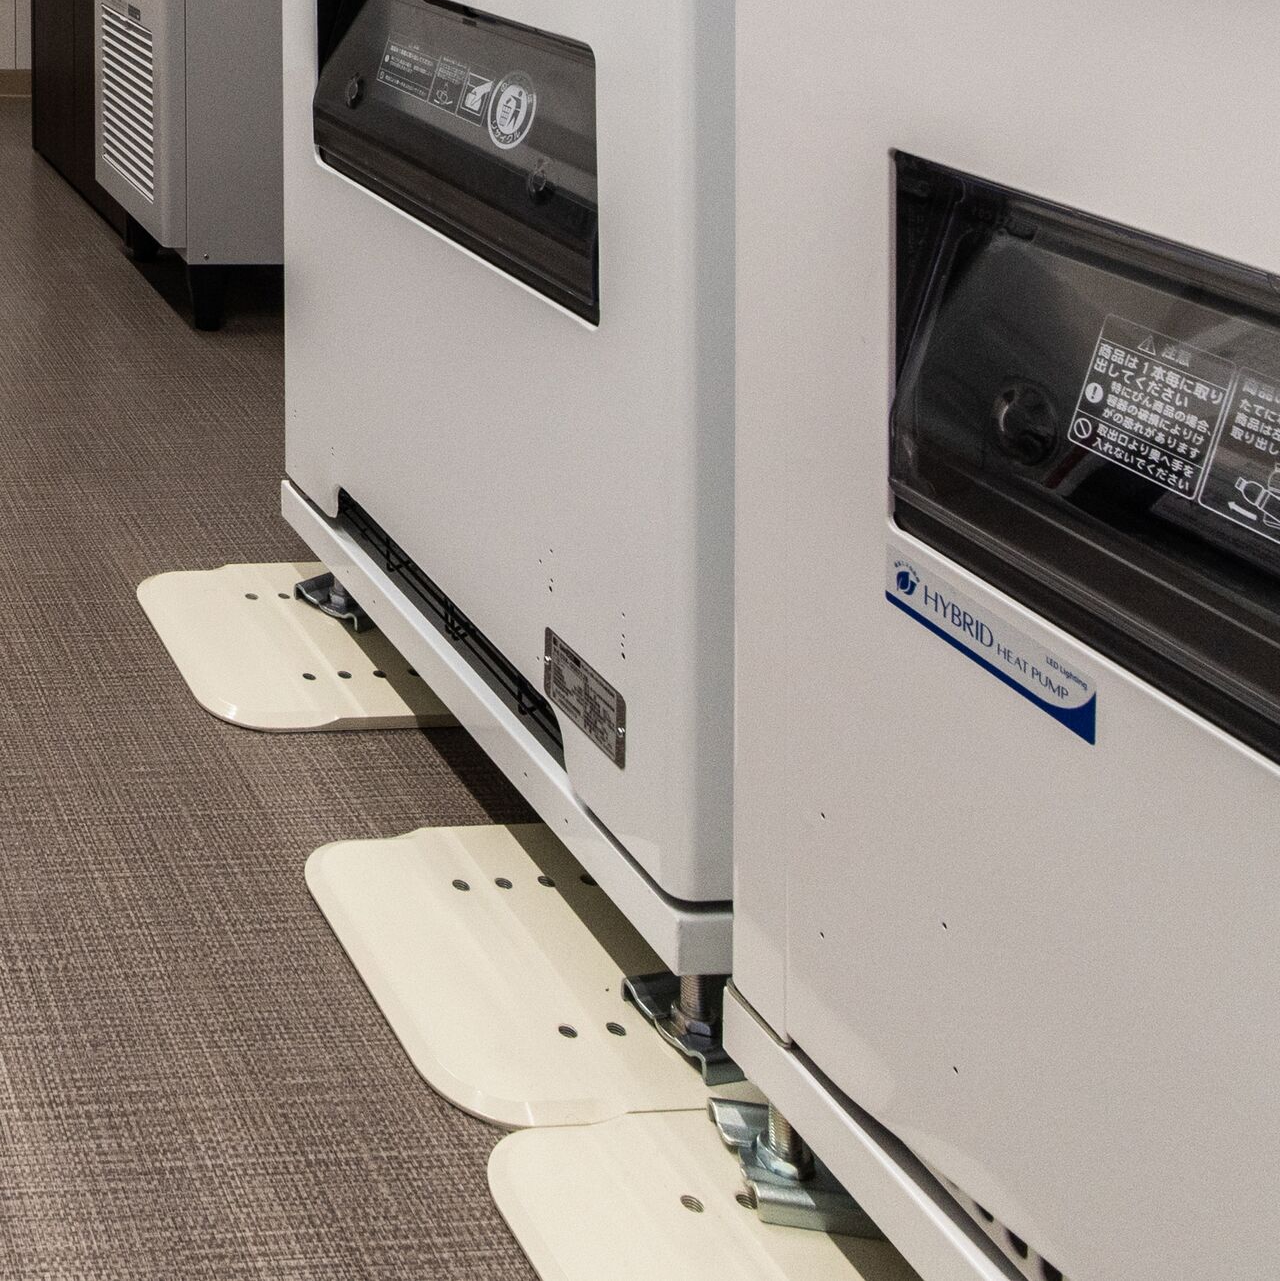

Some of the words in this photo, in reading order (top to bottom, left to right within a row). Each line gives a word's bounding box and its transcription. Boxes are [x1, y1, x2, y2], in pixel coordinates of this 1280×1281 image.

[1092, 357, 1190, 408] 出してください
[1090, 435, 1191, 492] 入れないでください
[924, 585, 995, 648] HYBRID
[996, 643, 1030, 674] HEAT
[1031, 666, 1070, 699] PUMP
